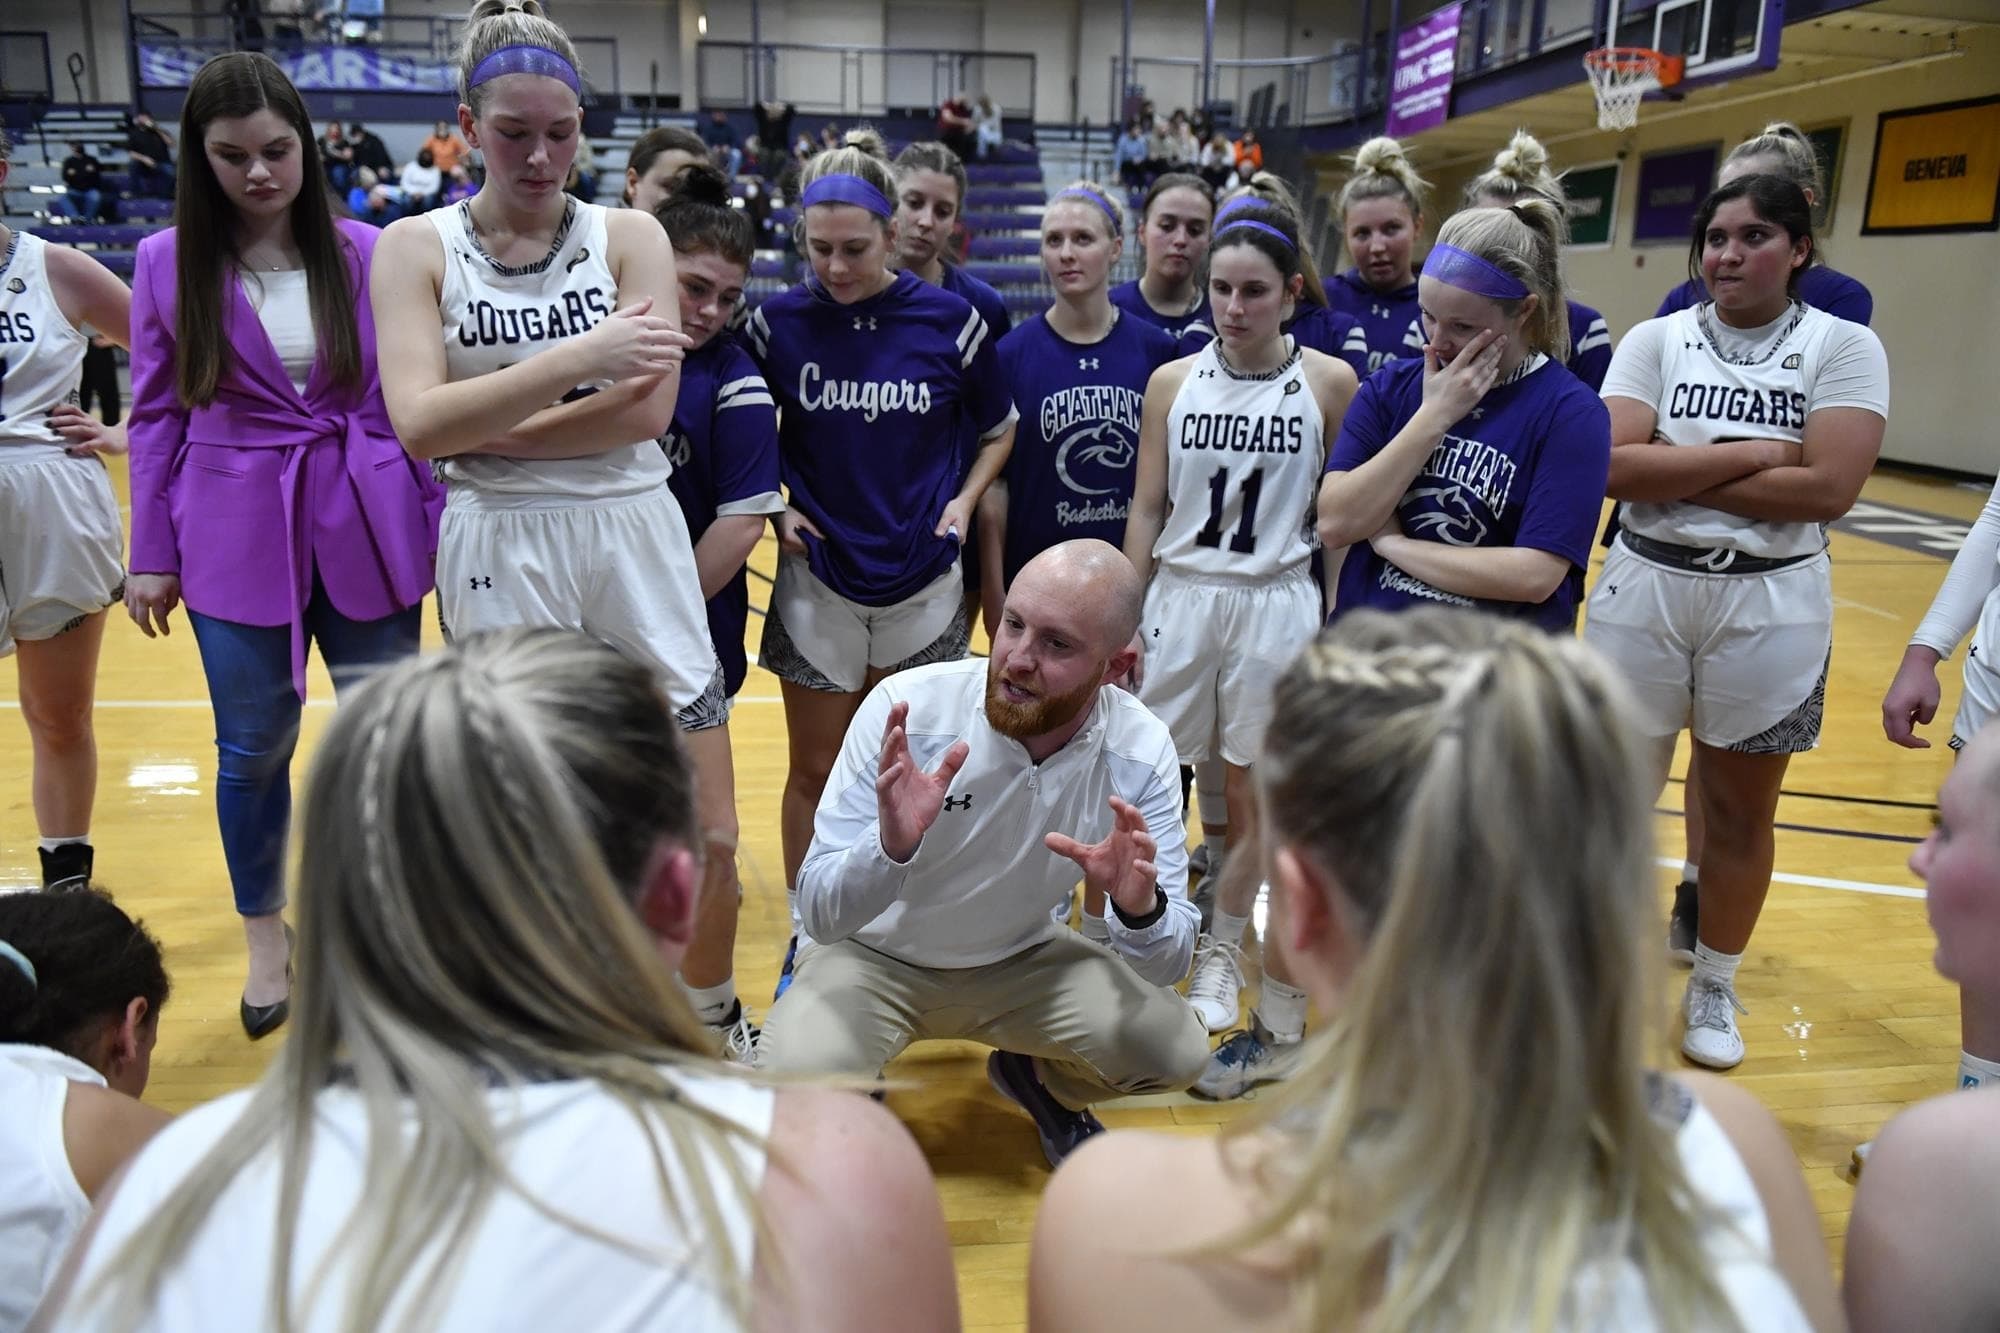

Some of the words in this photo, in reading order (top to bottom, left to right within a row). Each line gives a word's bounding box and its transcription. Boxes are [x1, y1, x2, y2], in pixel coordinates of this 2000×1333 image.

[1904, 153, 1968, 182] GENEVA
[459, 286, 609, 347] COUGARS
[799, 361, 932, 424] Cougars
[1671, 382, 1807, 430] COUGARS
[1181, 413, 1303, 455] COUGARS
[1194, 467, 1265, 554] 11
